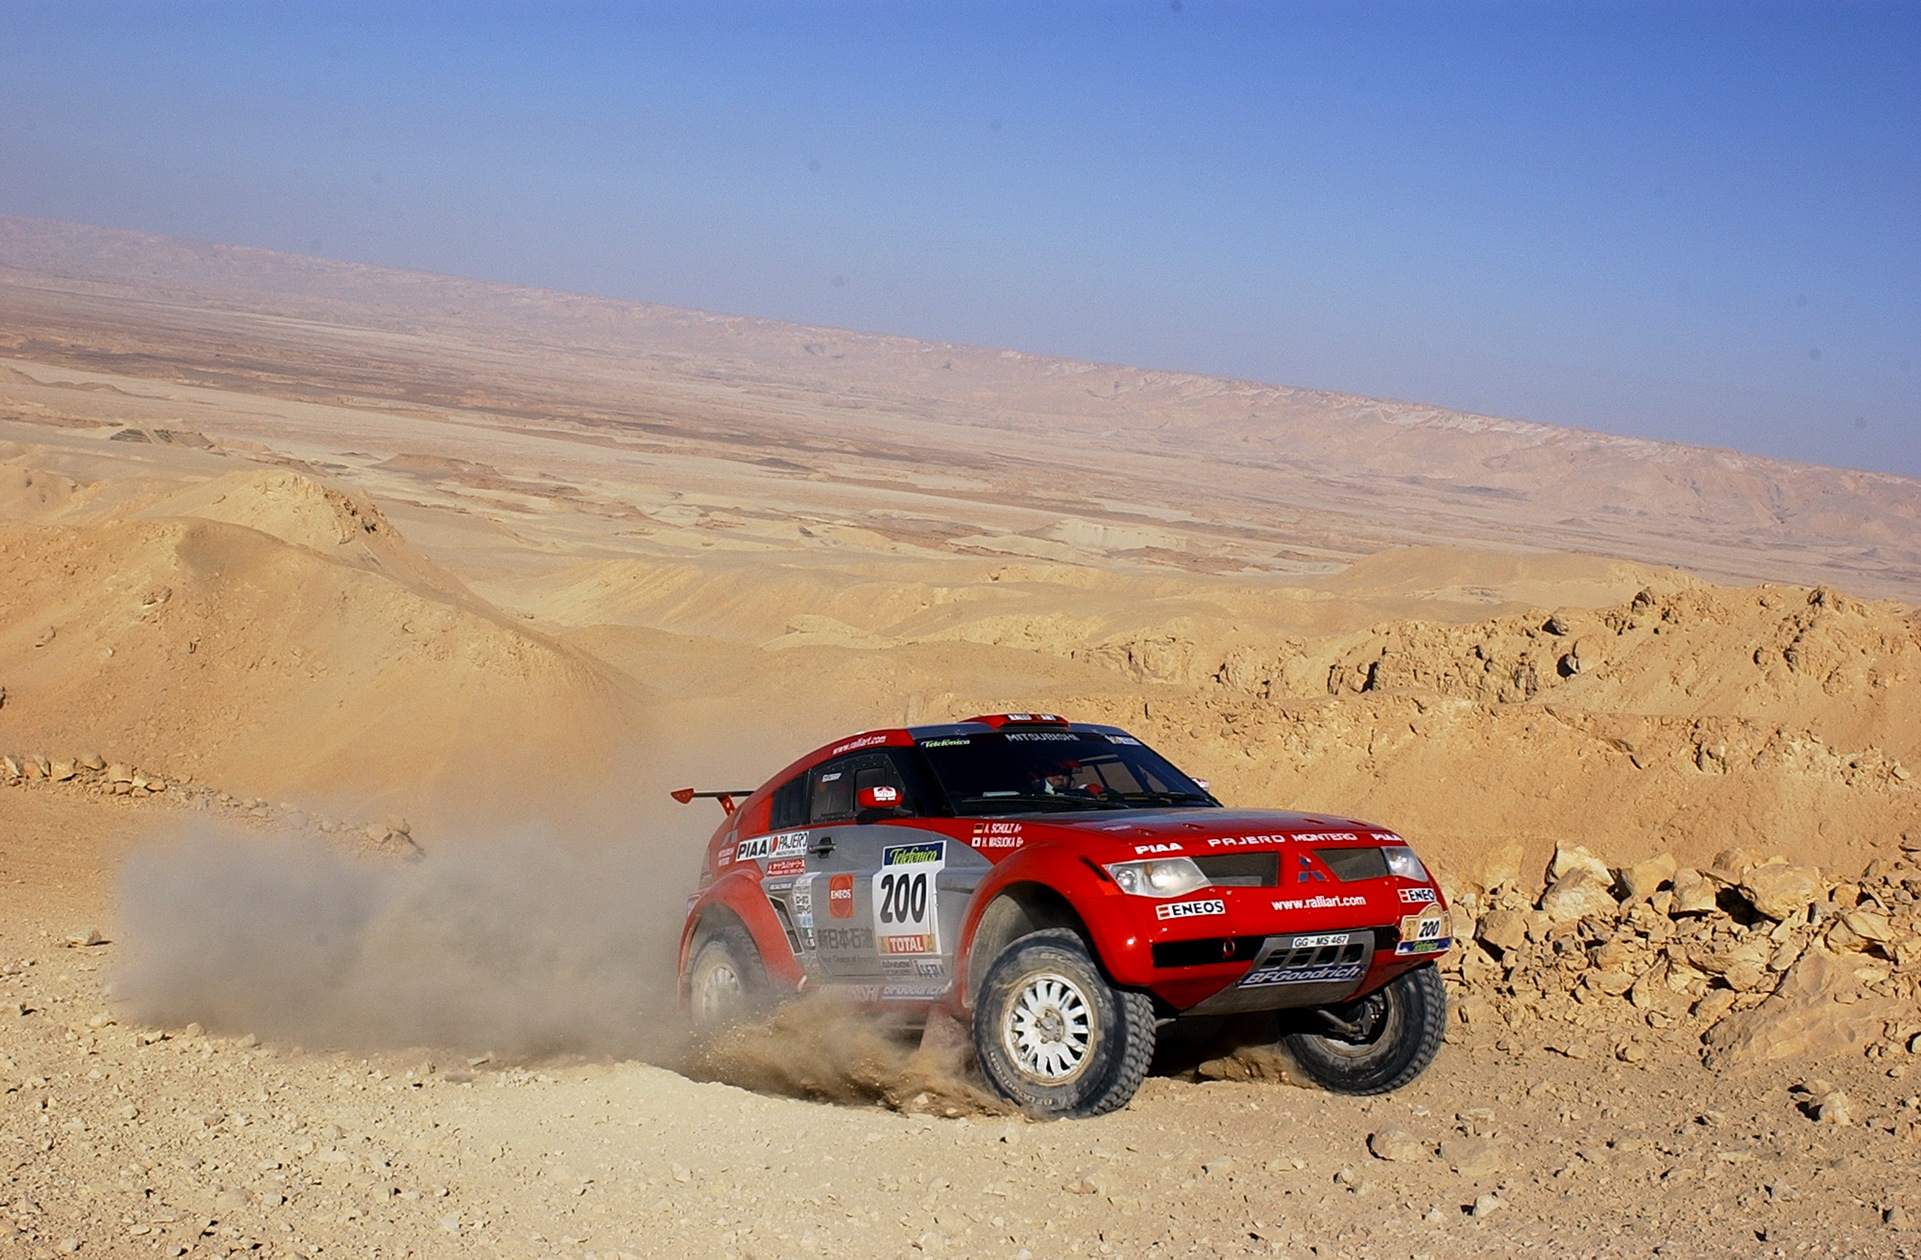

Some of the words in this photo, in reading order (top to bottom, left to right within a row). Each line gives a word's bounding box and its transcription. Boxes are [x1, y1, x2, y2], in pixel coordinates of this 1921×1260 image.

[1004, 733, 1080, 742] MITSUBISHI
[991, 823, 1014, 833] SCHULZ
[778, 832, 808, 849] PAJERO
[1207, 834, 1286, 847] PAJERO
[1290, 832, 1358, 842] MONTERO
[736, 839, 767, 859] PIAA
[1134, 842, 1184, 854] PIAA
[830, 888, 852, 899] ENEOS
[880, 872, 927, 924] 200
[1408, 888, 1435, 901] ENEO
[1172, 901, 1224, 916] ENEOS
[1271, 896, 1367, 911] www.ralliart.com
[1419, 920, 1440, 938] 200
[890, 937, 924, 952] TOTAL
[1242, 966, 1361, 984] BFGoodrich
